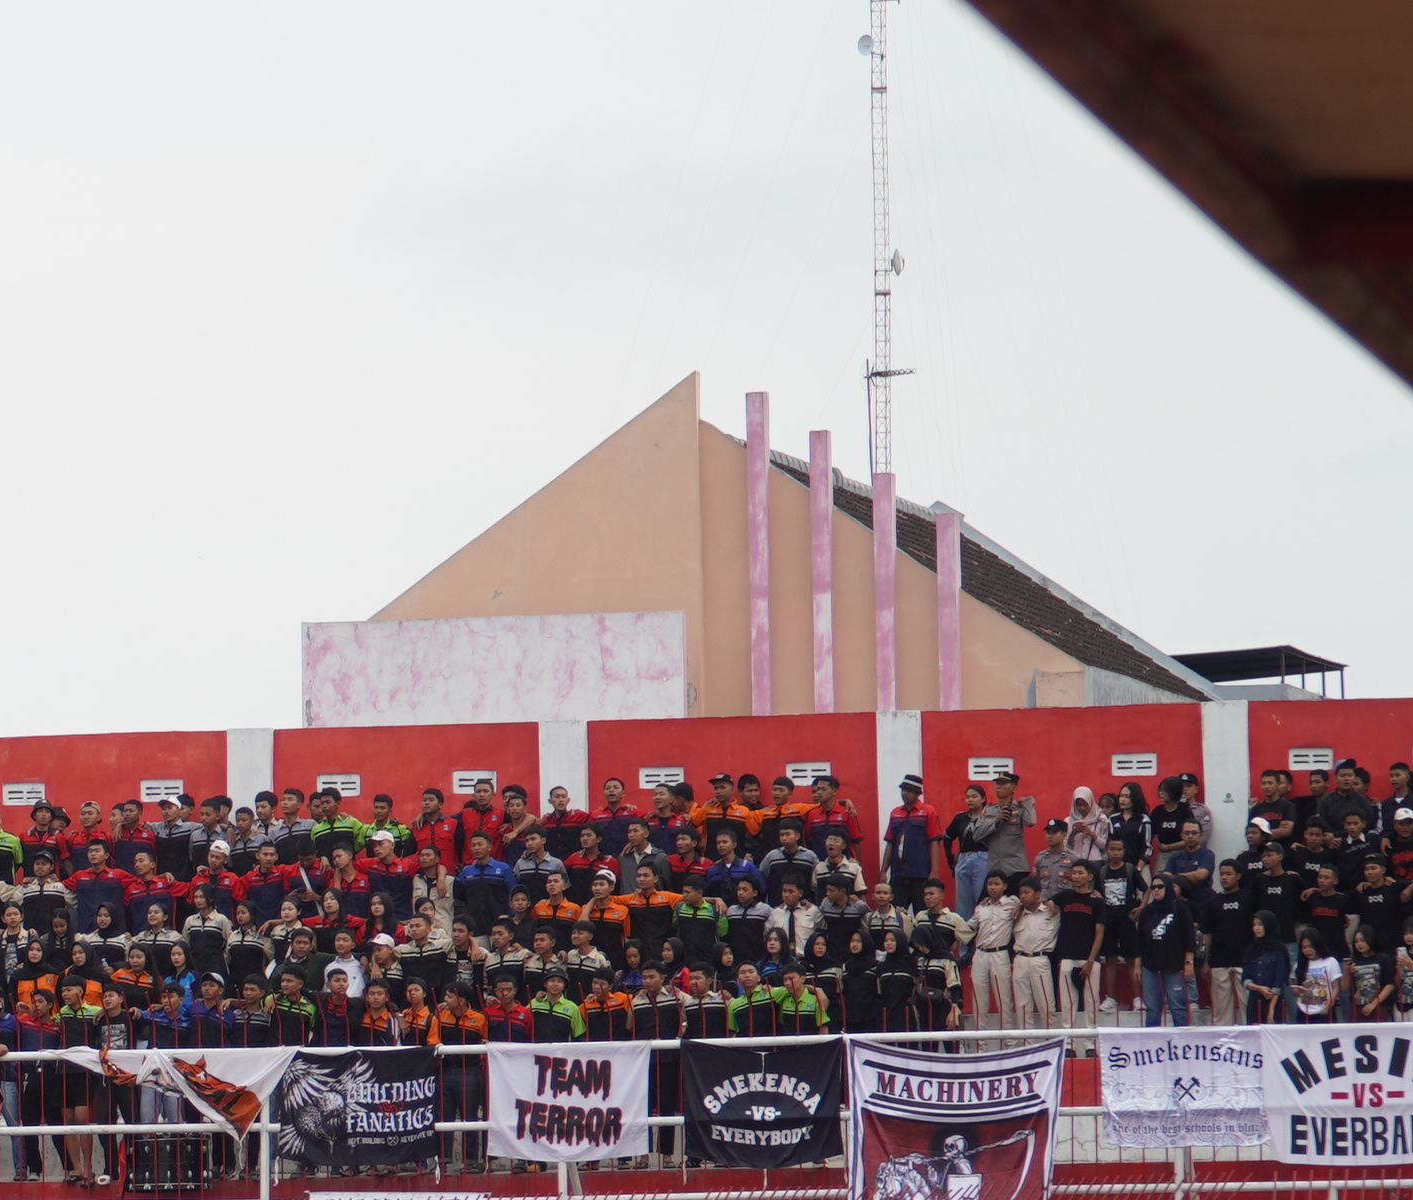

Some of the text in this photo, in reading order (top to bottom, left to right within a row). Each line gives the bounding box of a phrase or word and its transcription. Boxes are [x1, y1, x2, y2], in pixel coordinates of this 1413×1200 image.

[1107, 1039, 1264, 1071] Smekensans
[1279, 1034, 1413, 1096] MESI
[346, 1076, 436, 1104] BUILDING
[534, 1054, 612, 1101] TEAM
[703, 1072, 821, 1115] SMEKENSA
[876, 1070, 1040, 1103] MACHINERY
[346, 1104, 434, 1133] FANATICS
[514, 1099, 622, 1147] TERROR
[711, 1124, 813, 1146] EVERYBODY
[1184, 1123, 1222, 1133] schools
[1290, 1114, 1413, 1157] EVERBA
